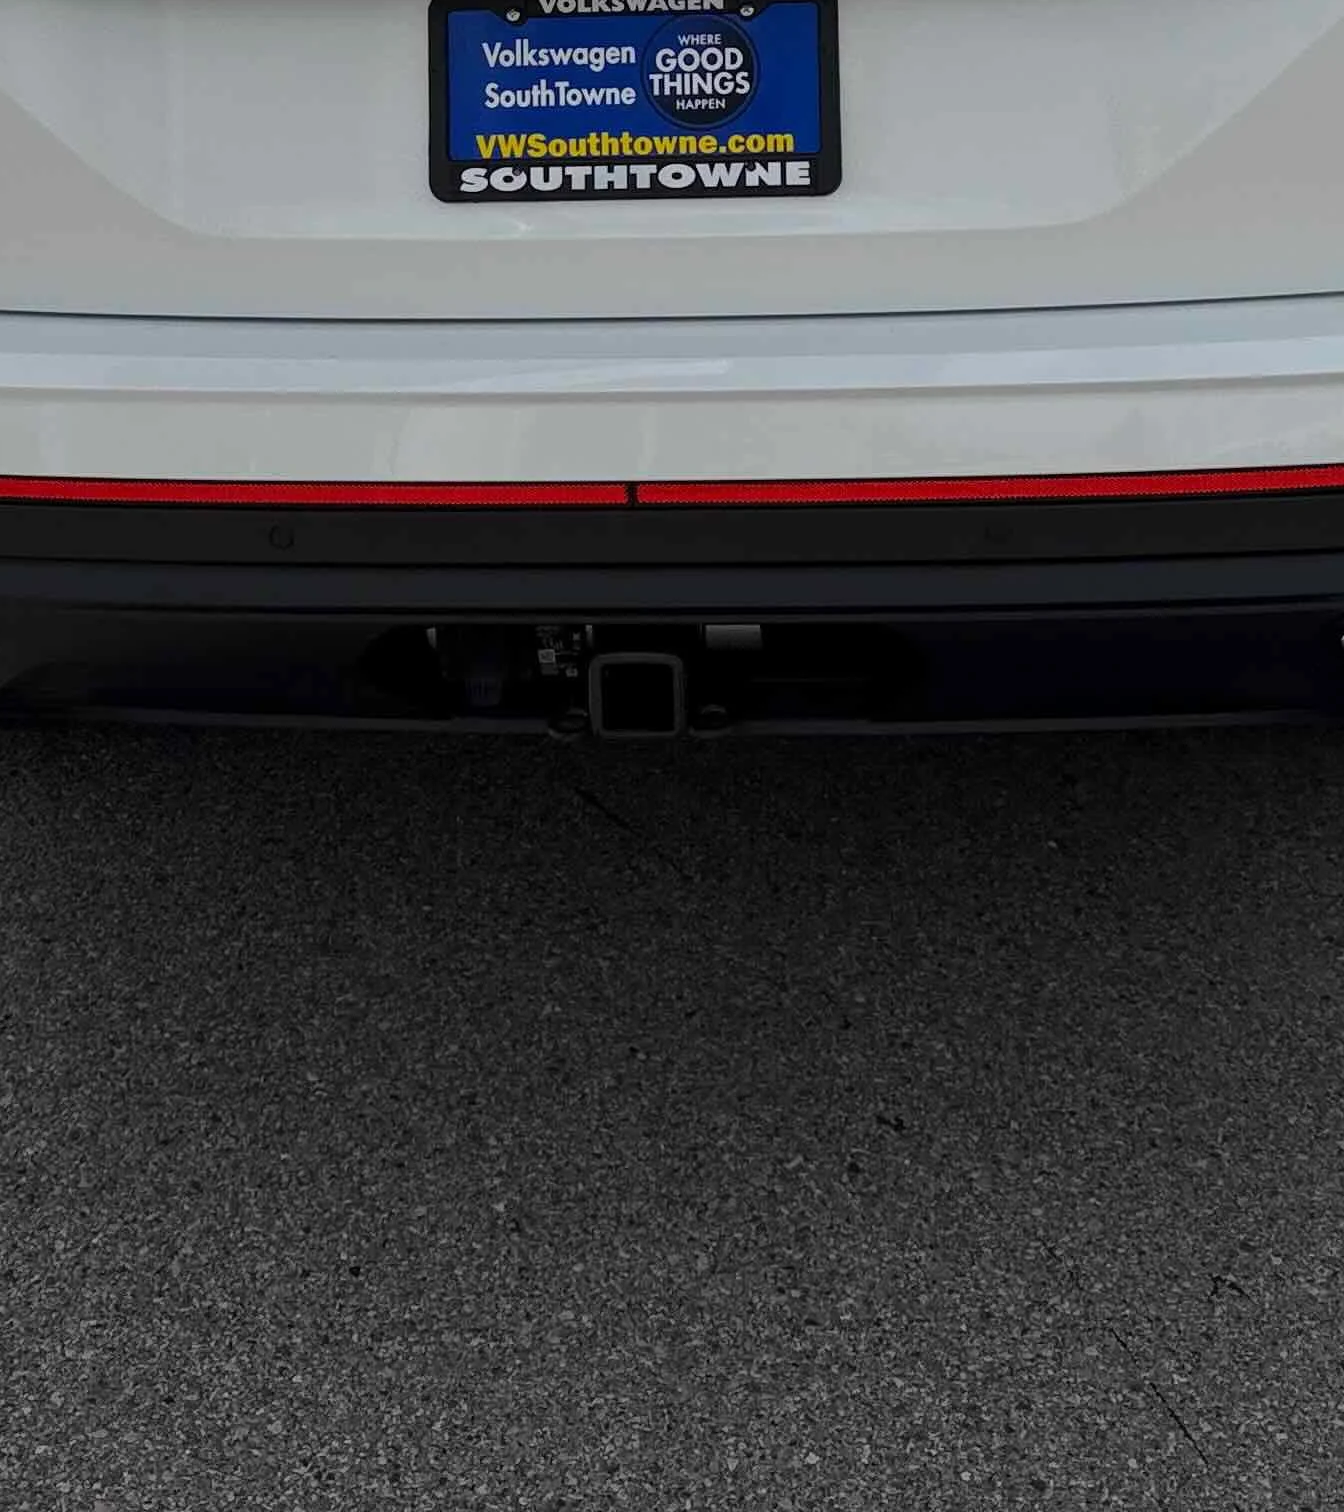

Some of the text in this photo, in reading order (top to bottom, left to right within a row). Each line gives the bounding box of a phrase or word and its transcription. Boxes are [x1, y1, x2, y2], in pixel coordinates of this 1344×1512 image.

[677, 33, 722, 46] WHERE
[482, 39, 636, 71] Volkswagen
[655, 47, 743, 73] GOOD
[485, 80, 636, 110] SouthTowne
[649, 72, 751, 96] THINGS
[676, 97, 726, 111] HAPPEN
[476, 133, 794, 159] VWSouthtowne.com
[460, 161, 811, 193] SOUTHTOWNE
